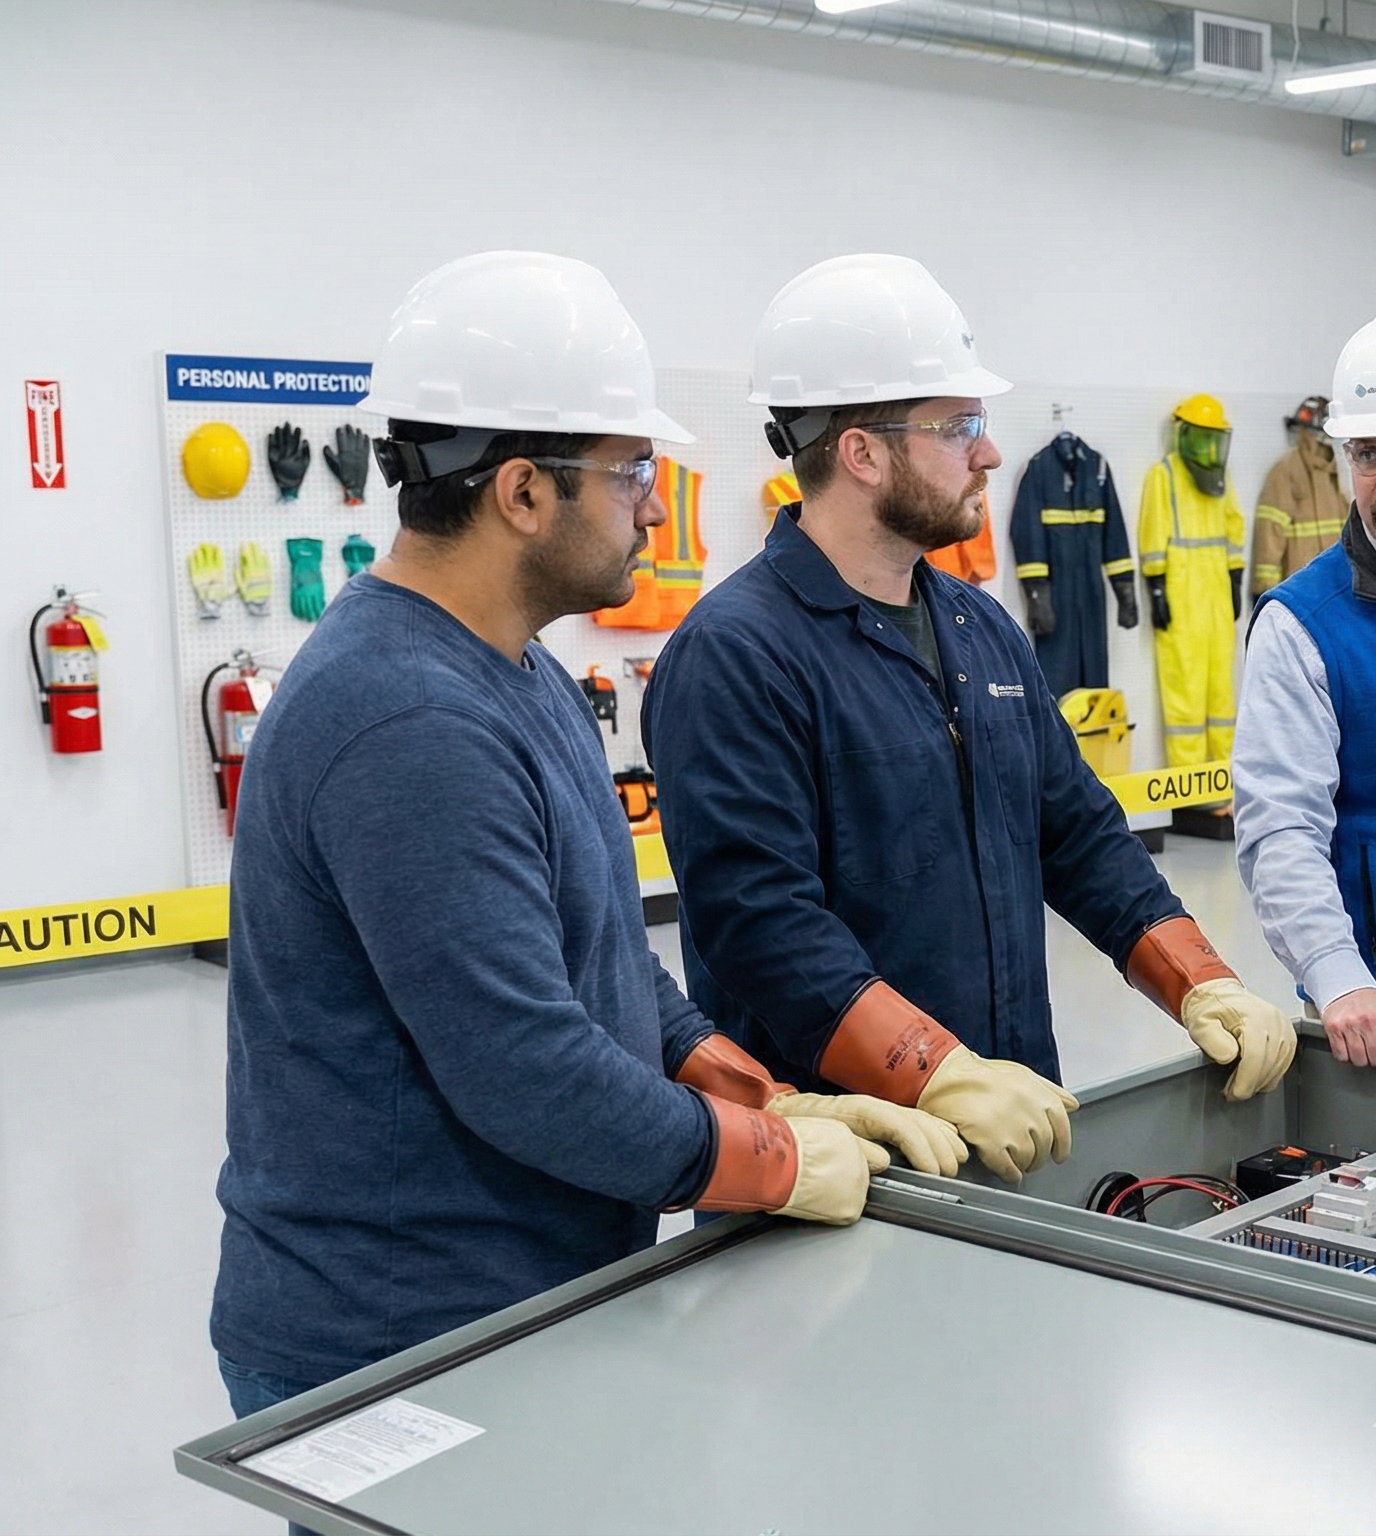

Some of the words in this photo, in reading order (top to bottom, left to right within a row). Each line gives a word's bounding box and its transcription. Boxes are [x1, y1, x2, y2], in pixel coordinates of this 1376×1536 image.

[177, 368, 270, 390] PERSONAL
[1147, 768, 1233, 802] CAUTIO
[0, 904, 156, 952] AUTION
